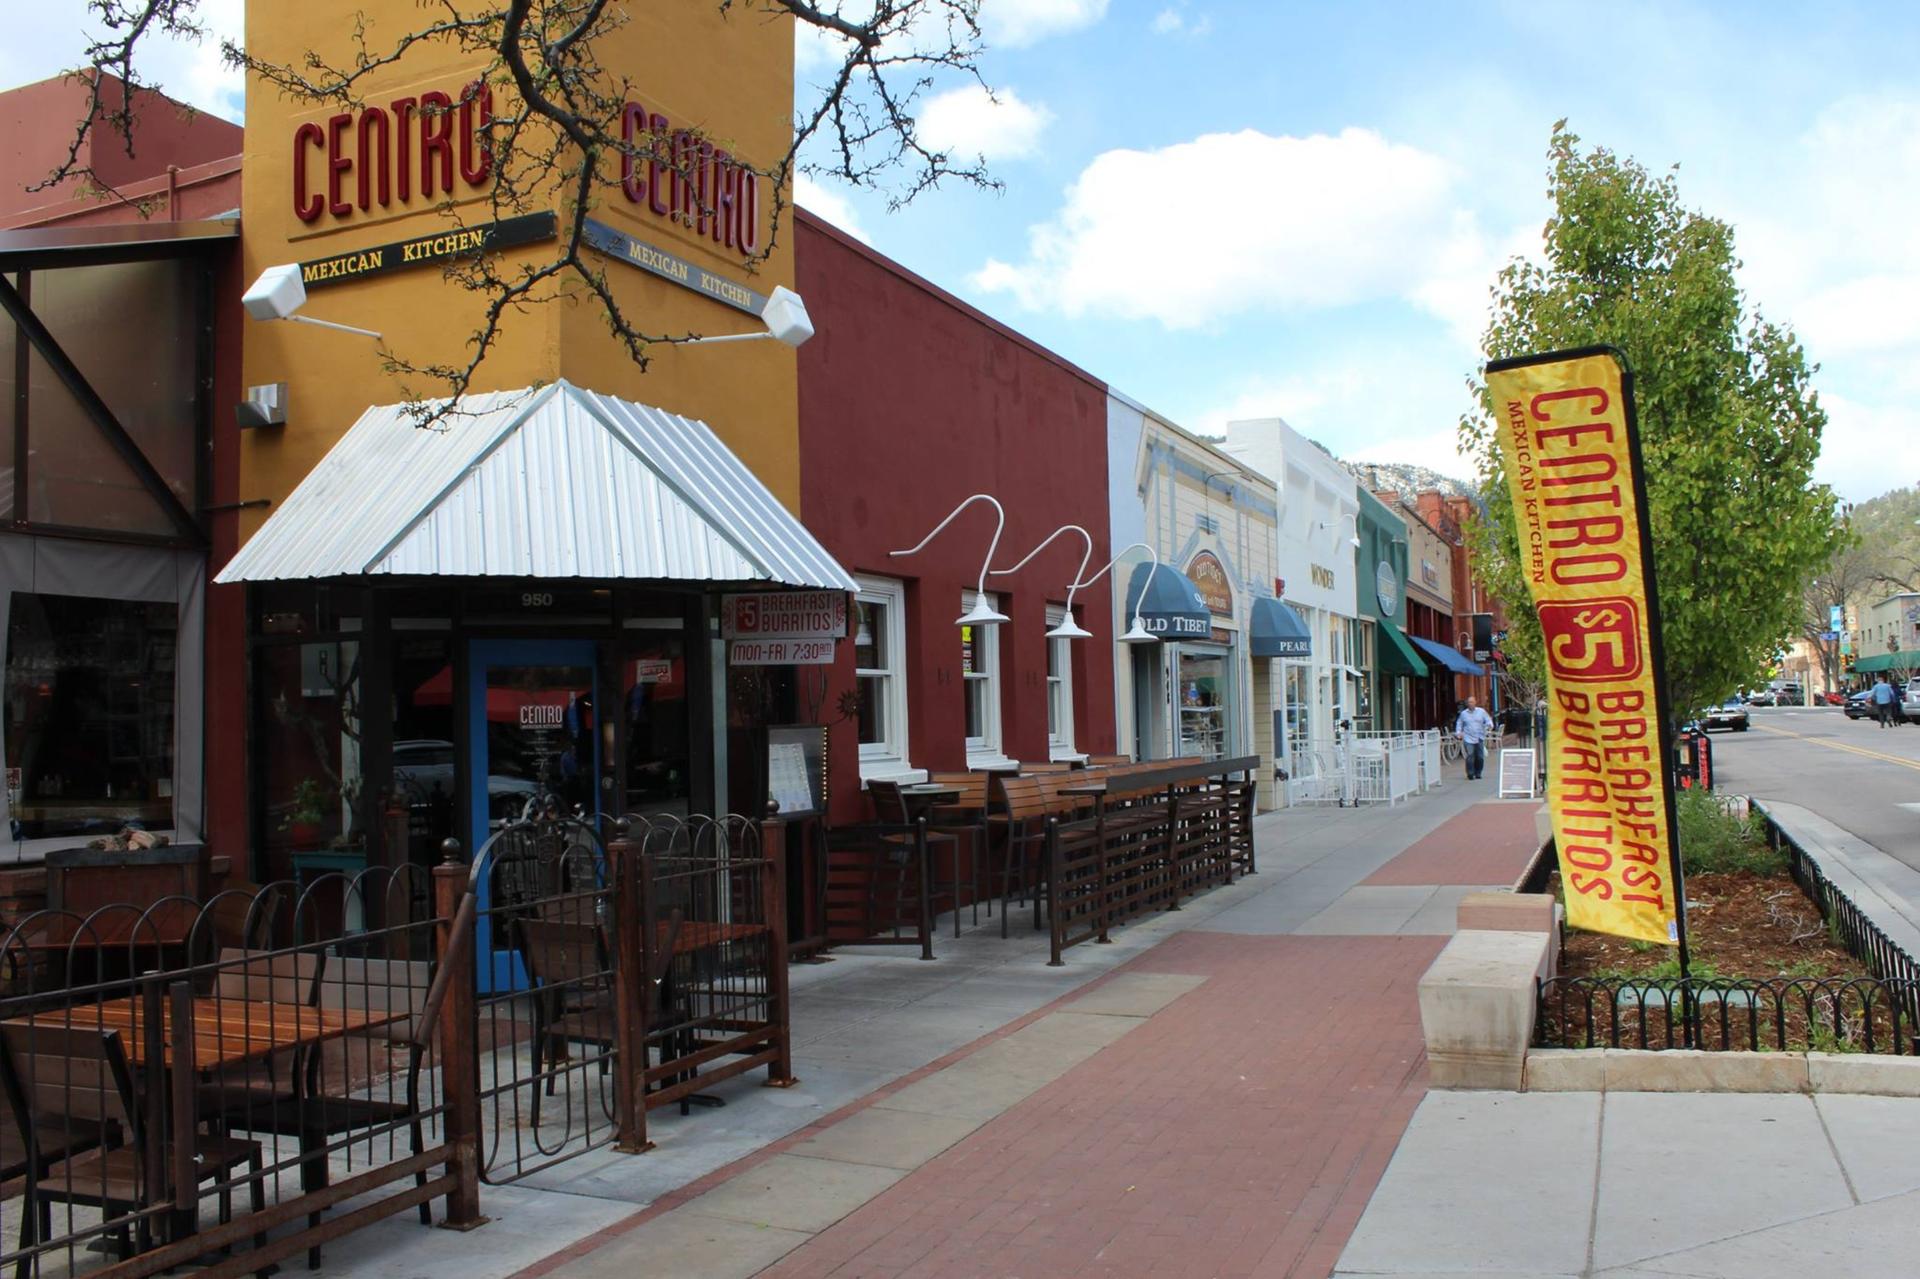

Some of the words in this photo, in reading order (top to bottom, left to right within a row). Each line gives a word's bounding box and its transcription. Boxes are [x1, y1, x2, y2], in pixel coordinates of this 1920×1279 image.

[294, 81, 493, 222] CENTRO
[622, 102, 759, 256] CENTRO
[304, 251, 383, 283] MEXICAN
[403, 230, 484, 262] KITCHEN
[630, 241, 688, 281] MEXICAN
[701, 273, 751, 306] KITCHEN
[1507, 400, 1536, 492] MEXICAN
[1524, 497, 1545, 584] KITCHEN
[1530, 387, 1628, 586] CENTRO
[522, 593, 553, 606] 950
[762, 593, 831, 612] BREAKFAST
[762, 612, 831, 632] BURRITOS
[1172, 616, 1207, 633] TIBET
[733, 643, 787, 661] MON-FRI
[1280, 641, 1308, 652] PEARL
[1552, 608, 1626, 668] $5
[520, 704, 563, 724] CENTRO
[1556, 688, 1613, 901] BURRITOS
[1597, 690, 1664, 911] BREAKFAST
